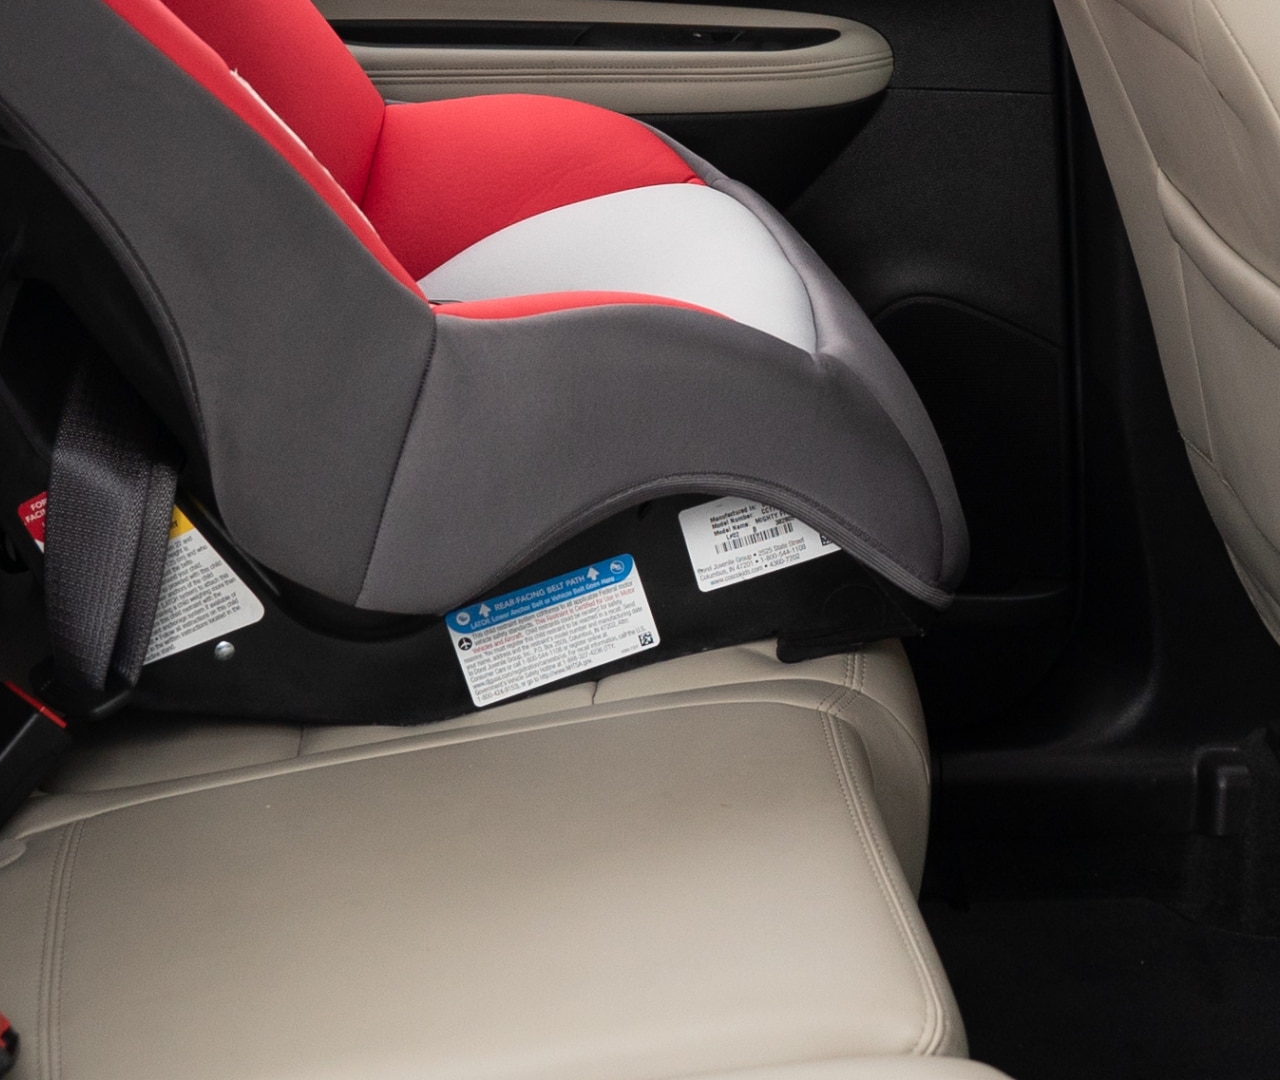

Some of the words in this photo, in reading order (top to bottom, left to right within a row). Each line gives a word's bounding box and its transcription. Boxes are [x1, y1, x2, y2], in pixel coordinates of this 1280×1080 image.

[710, 506, 748, 522] Manufactured
[712, 520, 728, 528] Model
[714, 528, 730, 536] Model
[755, 512, 778, 523] MIGHTY
[714, 560, 734, 570] Juvenile
[736, 555, 752, 563] Group
[774, 543, 788, 551] State
[789, 537, 804, 546] Street
[700, 570, 728, 581] Columbus,
[736, 561, 753, 569] 47201
[491, 612, 509, 622] Lower
[511, 605, 530, 616] Anchor
[531, 600, 544, 608] Belt
[551, 591, 572, 601] Vehicle
[573, 586, 585, 594] Belt
[586, 582, 600, 590] Goes
[601, 576, 615, 584] Here
[494, 589, 545, 610] REAR-FACING
[546, 582, 563, 593] BELT
[566, 576, 585, 586] PATH
